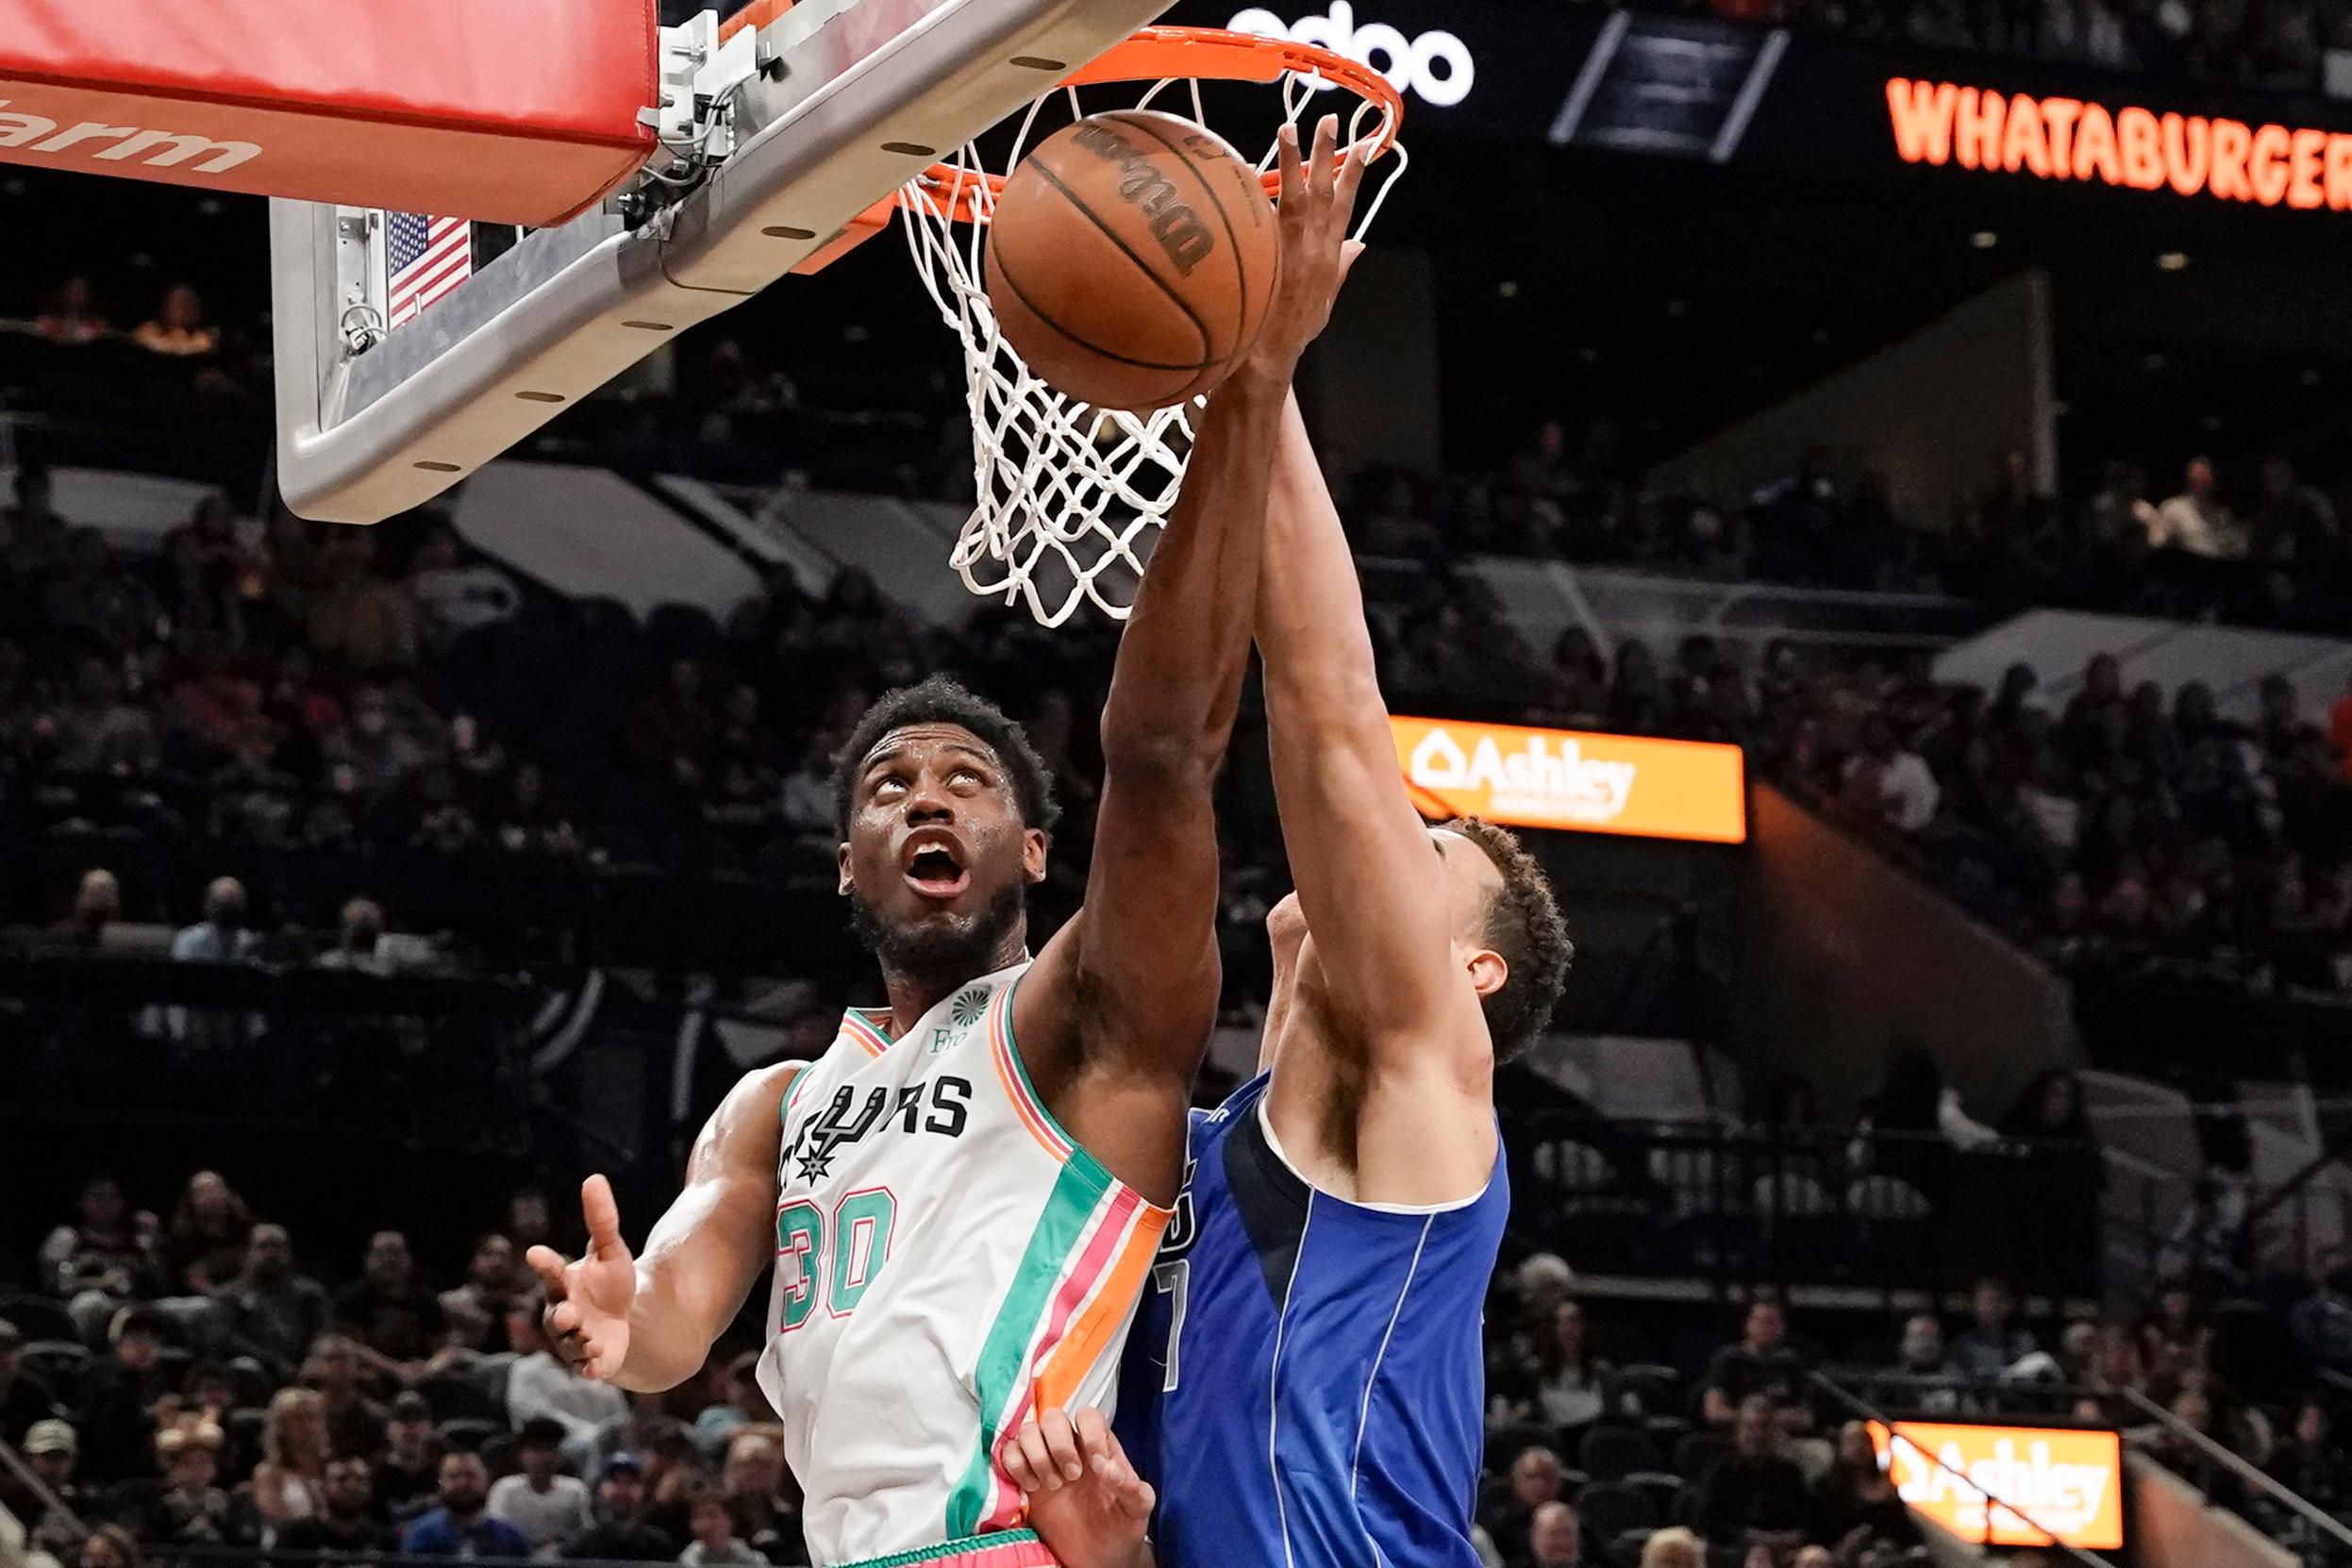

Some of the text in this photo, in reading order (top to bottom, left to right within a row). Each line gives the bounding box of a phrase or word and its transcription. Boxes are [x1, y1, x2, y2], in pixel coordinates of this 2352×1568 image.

[0, 100, 262, 174] arm
[1886, 76, 2352, 211] WHATABURGER
[1070, 123, 1215, 278] Wilson
[1465, 735, 1637, 817] Ashley
[775, 1186, 897, 1333] 30
[1929, 1439, 2110, 1526] Ashley
